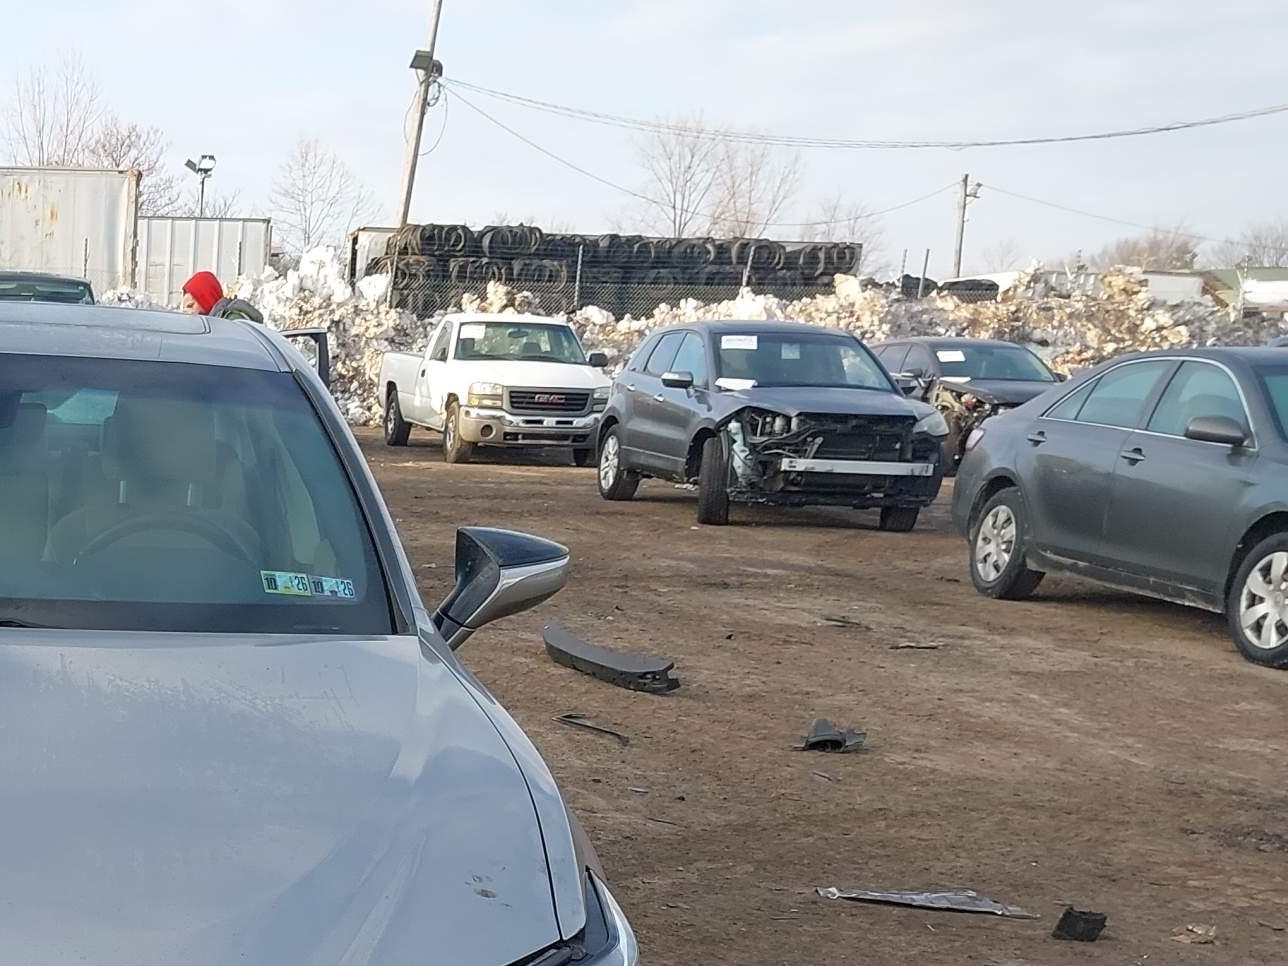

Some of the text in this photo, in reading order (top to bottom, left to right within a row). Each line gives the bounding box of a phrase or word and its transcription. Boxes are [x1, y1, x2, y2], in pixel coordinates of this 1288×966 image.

[264, 576, 308, 592] 10 26
[340, 581, 354, 597] 26
